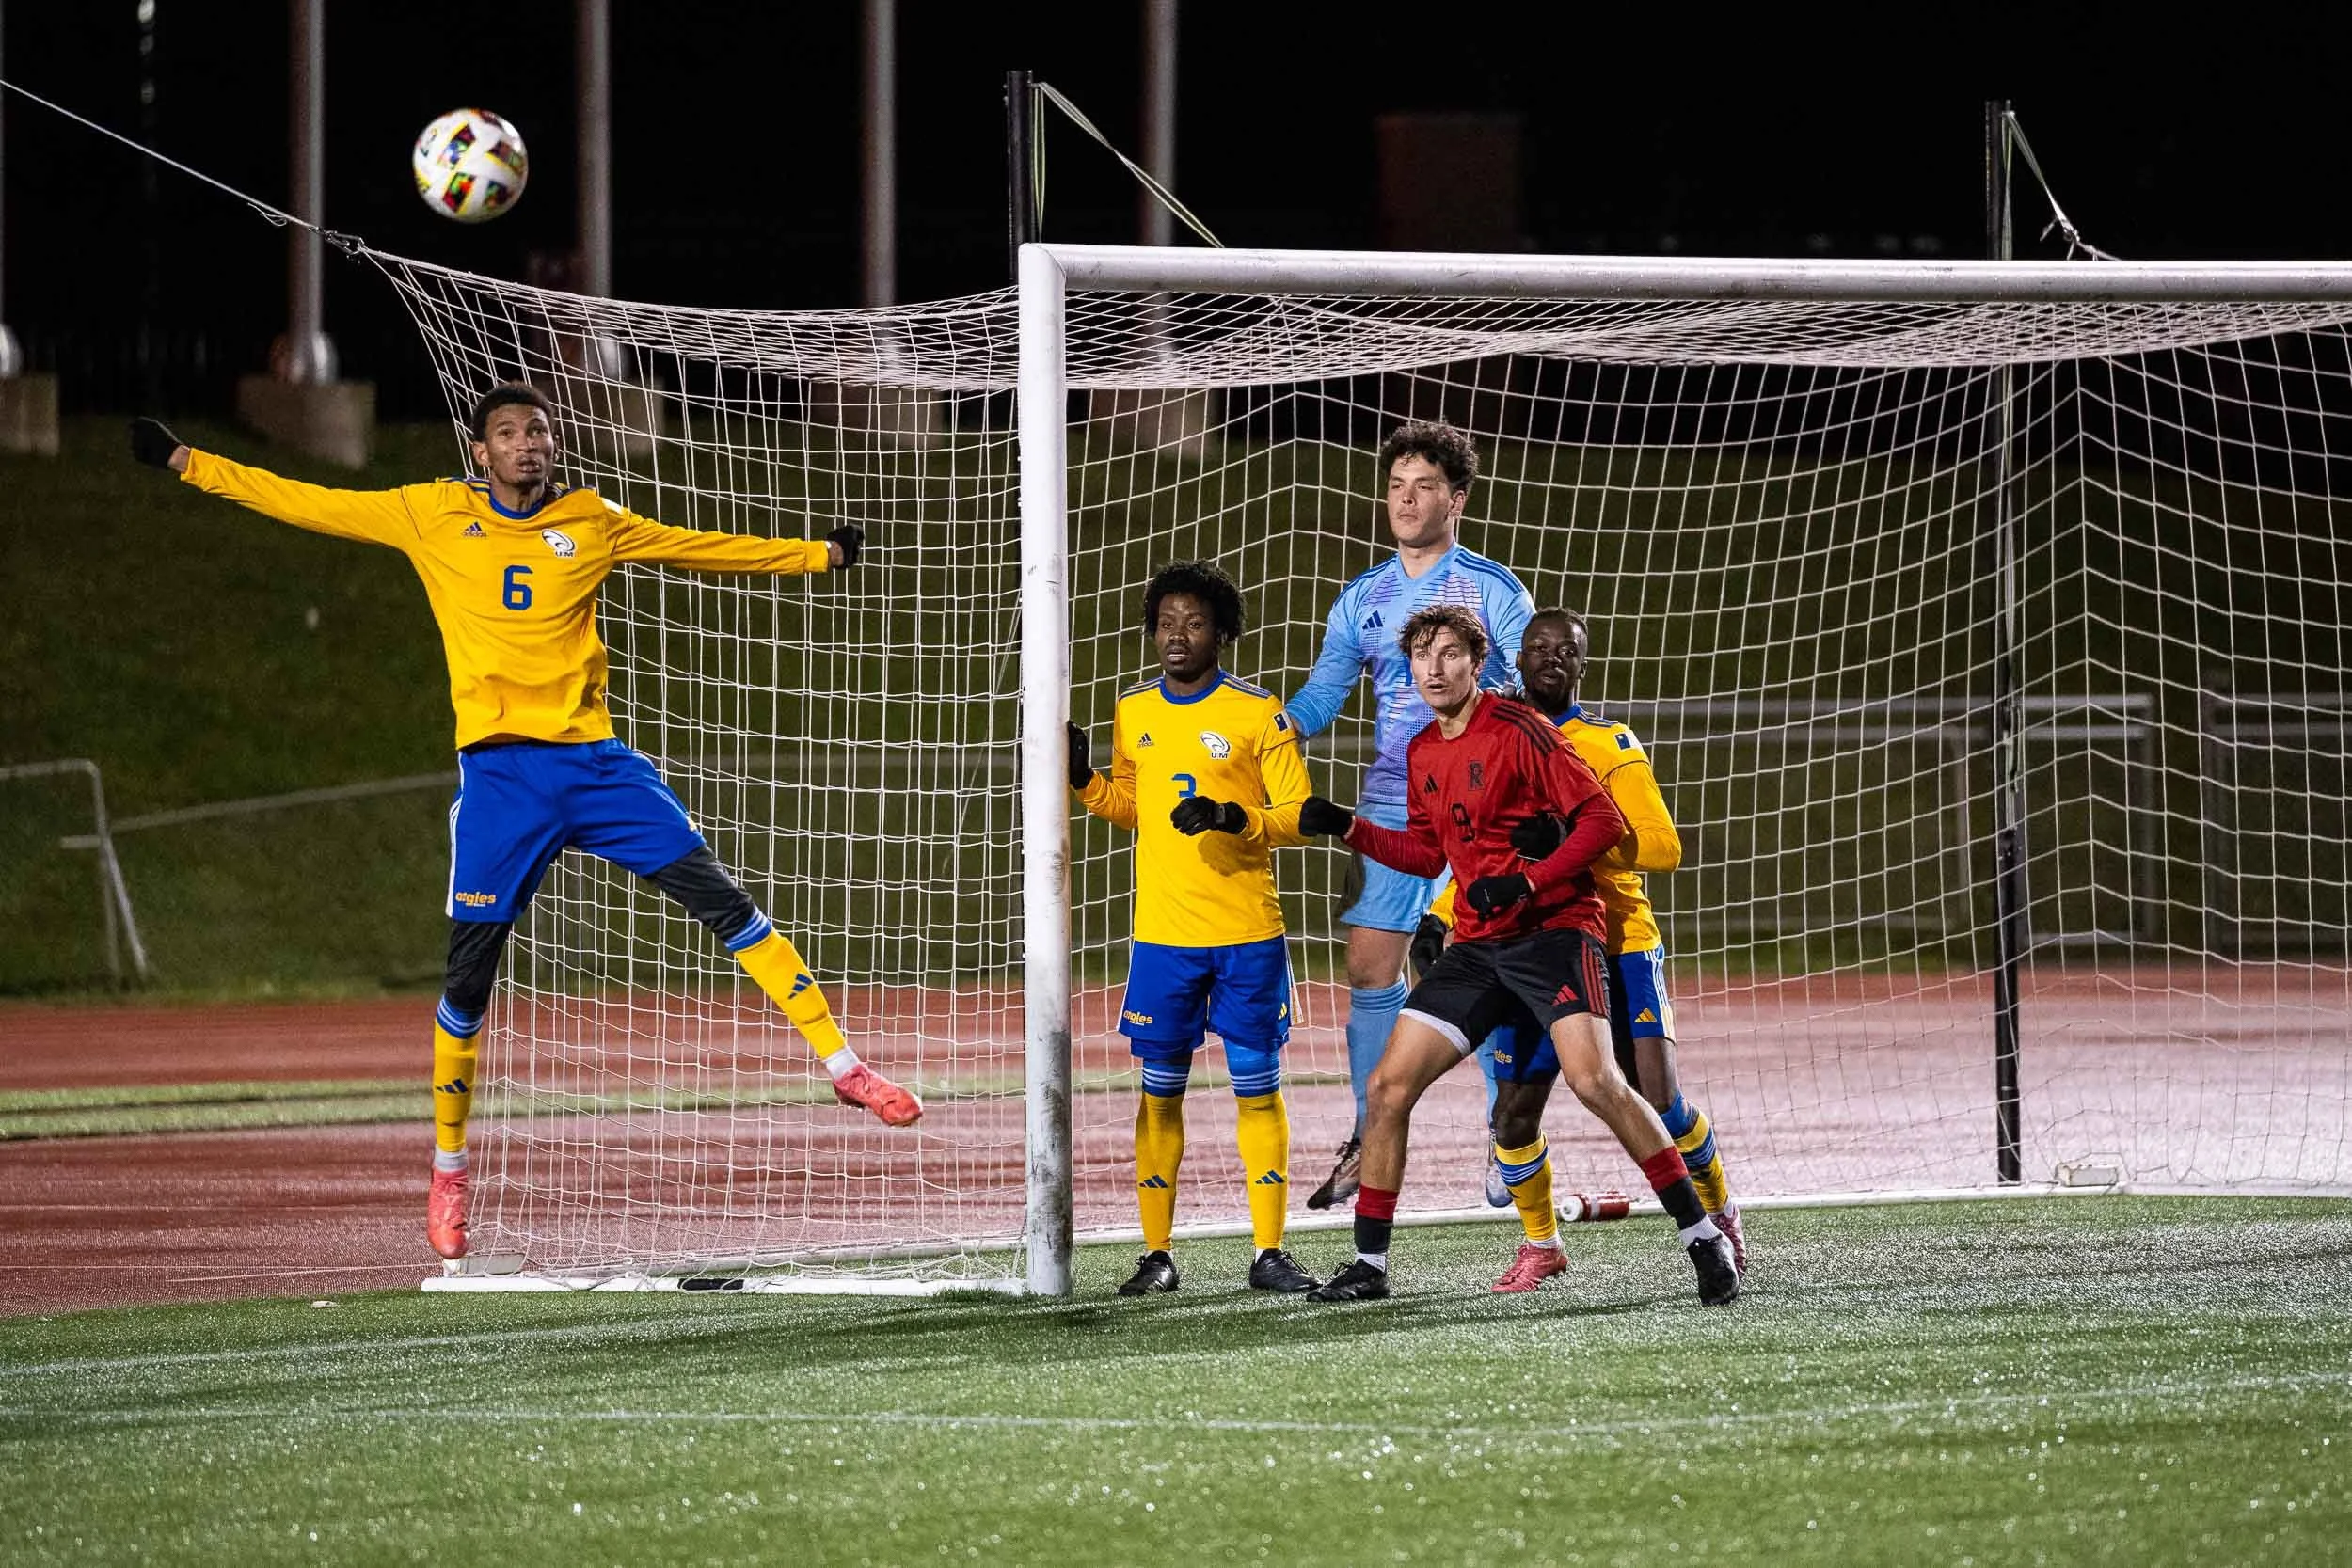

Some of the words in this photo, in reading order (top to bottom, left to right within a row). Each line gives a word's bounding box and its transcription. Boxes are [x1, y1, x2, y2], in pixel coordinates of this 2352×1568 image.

[502, 564, 533, 610] 6
[1470, 762, 1485, 789] R
[1452, 802, 1475, 842] 9
